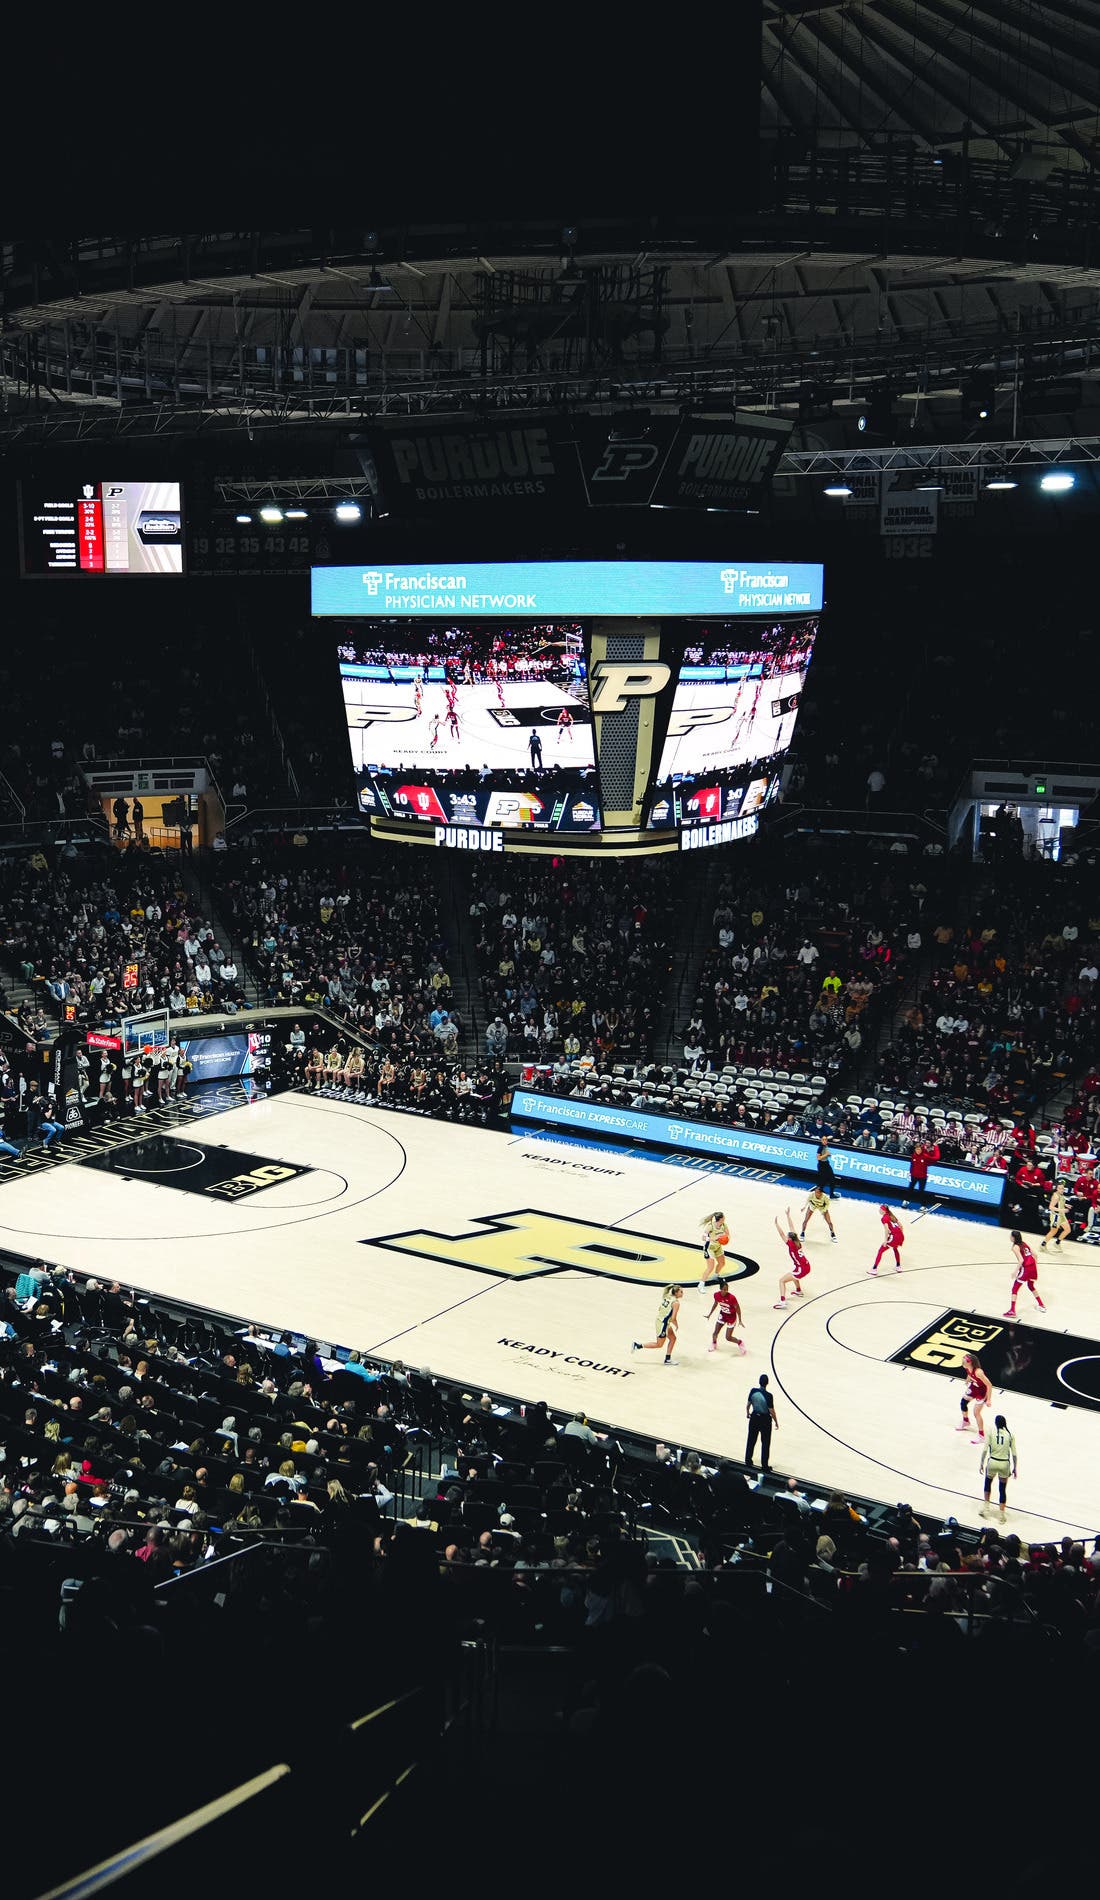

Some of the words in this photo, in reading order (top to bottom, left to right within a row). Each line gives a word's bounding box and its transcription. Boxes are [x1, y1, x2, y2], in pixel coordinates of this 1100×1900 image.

[391, 428, 556, 483] PURDUE
[677, 434, 777, 482] PURDUE
[416, 480, 547, 501] BOILERMAKERS
[945, 483, 974, 496] FOUR
[887, 506, 931, 517] NATIONAL
[884, 516, 934, 526] CHAMPIONS
[216, 537, 236, 553] 32
[240, 537, 260, 553] 35
[264, 537, 285, 553] 43
[288, 537, 309, 553] 42
[883, 536, 933, 558] 1932
[385, 573, 467, 591] Franciscan
[739, 571, 789, 588] Franciscan
[385, 595, 456, 609] PHYSICIAN
[460, 594, 537, 608] NETWORK
[739, 593, 783, 607] PHYSICIAN
[591, 662, 672, 712] P
[393, 792, 408, 805] 10
[449, 793, 477, 806] 3:43
[687, 799, 700, 811] 10
[531, 803, 541, 814] 5
[435, 826, 505, 852] PURDUE
[682, 814, 757, 850] BOILERMAKERS
[124, 973, 139, 988] 25
[260, 1034, 271, 1043] 10
[265, 1057, 272, 1066] 5
[537, 1101, 586, 1120] Franciscan
[588, 1112, 649, 1132] EXPRESSCARE
[65, 1119, 84, 1131] PIONEER
[684, 1127, 740, 1149] Franciscan
[741, 1141, 809, 1161] EXPRESSCARE
[521, 1153, 572, 1166] KEADY
[571, 1163, 626, 1177] COURT
[662, 1153, 785, 1183] PURDUE
[927, 1174, 990, 1194] PRESSCARE
[496, 1337, 565, 1359] KEADY
[563, 1355, 636, 1379] COURT
[996, 1435, 1005, 1446] 11
